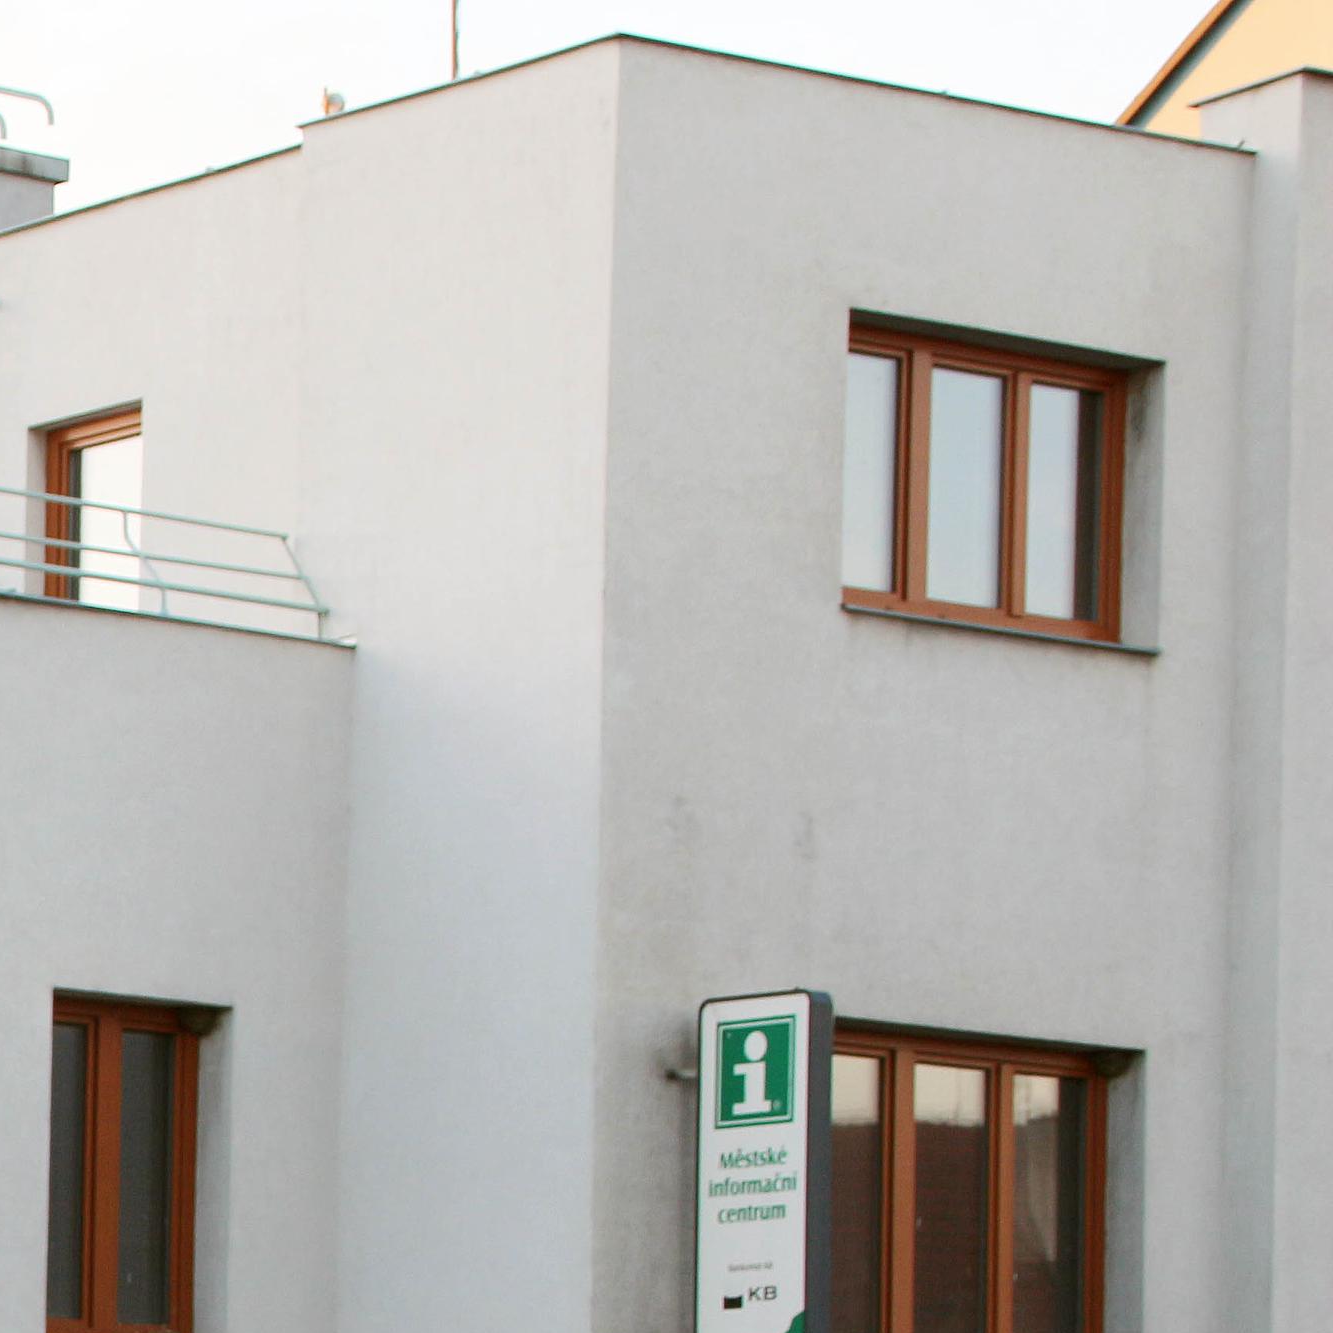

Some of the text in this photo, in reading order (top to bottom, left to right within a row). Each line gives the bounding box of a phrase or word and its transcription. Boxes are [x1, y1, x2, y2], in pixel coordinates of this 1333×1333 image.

[719, 1148, 788, 1170] Městské
[708, 1171, 798, 1197] informační
[718, 1203, 786, 1224] centrum
[748, 1286, 778, 1301] KB
